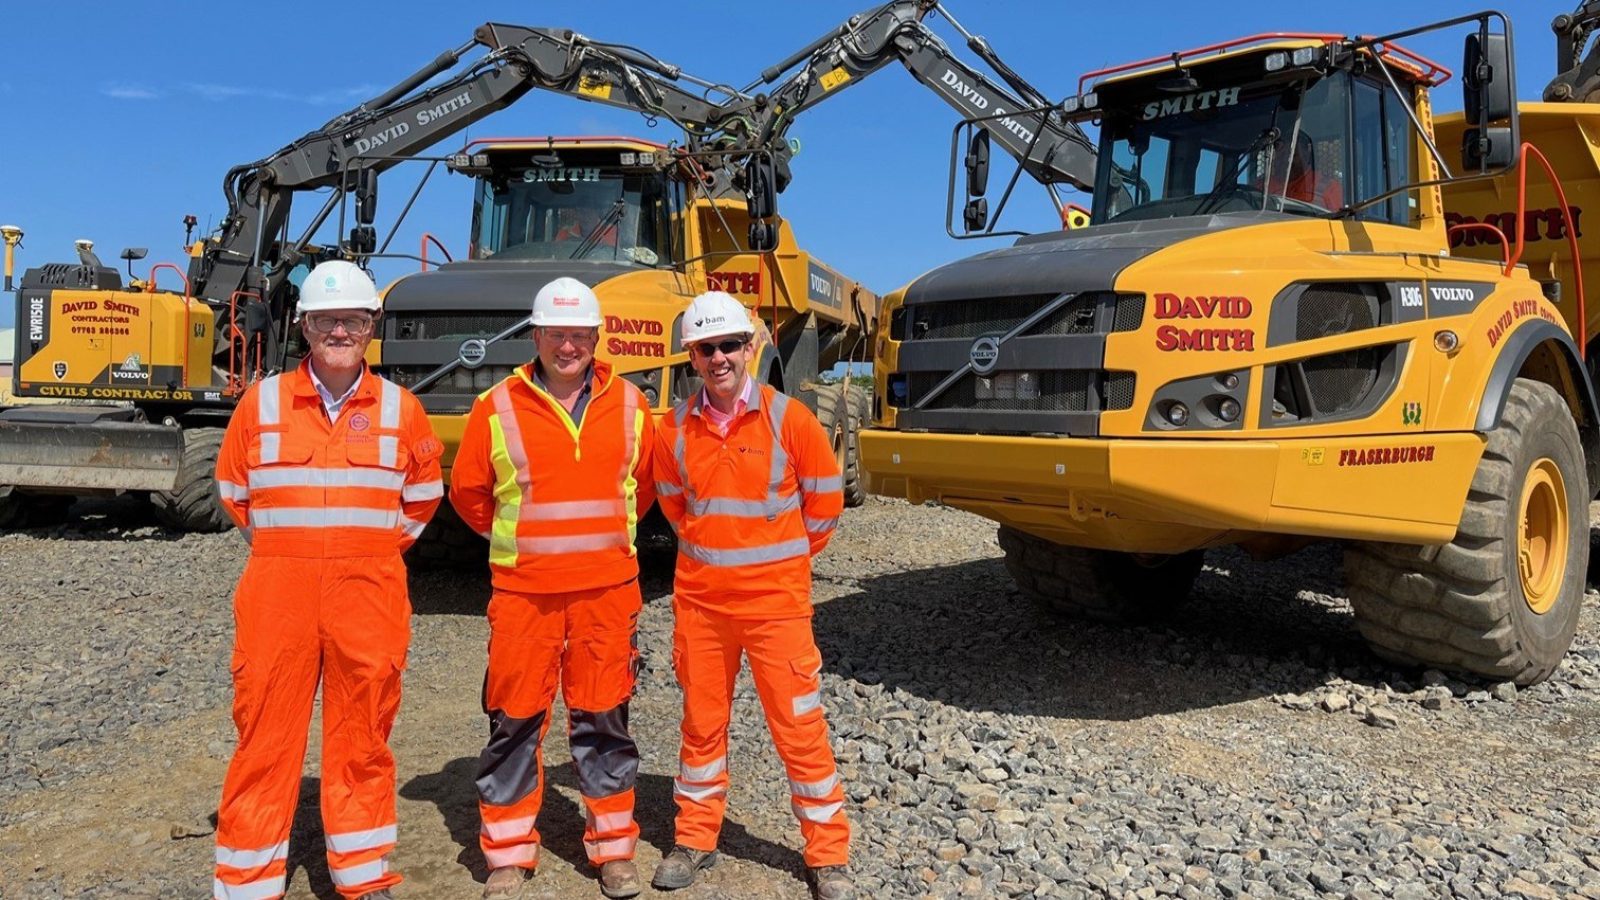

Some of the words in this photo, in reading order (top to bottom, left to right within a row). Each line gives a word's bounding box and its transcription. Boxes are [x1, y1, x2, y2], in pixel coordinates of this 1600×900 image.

[941, 69, 988, 110] DAVID
[992, 108, 1040, 147] SMITH
[1143, 88, 1241, 120] SMITH
[355, 122, 409, 154] DAVID
[416, 92, 472, 126] SMITH
[523, 167, 600, 182] SMITH
[1430, 287, 1474, 302] VOLVO
[62, 301, 98, 315] DAVID
[103, 300, 140, 316] SMITH
[1152, 292, 1252, 320] DAVID
[30, 297, 44, 341] EWR150E
[71, 315, 130, 324] CONTRACTORS
[605, 315, 664, 336] DAVID
[705, 316, 726, 325] bam
[1487, 311, 1513, 348] DAVID
[1513, 299, 1538, 317] SMITH
[607, 338, 666, 358] SMITH
[1155, 325, 1255, 352] SMITH
[112, 371, 149, 379] VOLVO
[39, 386, 88, 397] CIVILS
[92, 387, 193, 401] CONTRACTOR
[1338, 446, 1435, 467] FRASERBURGH
